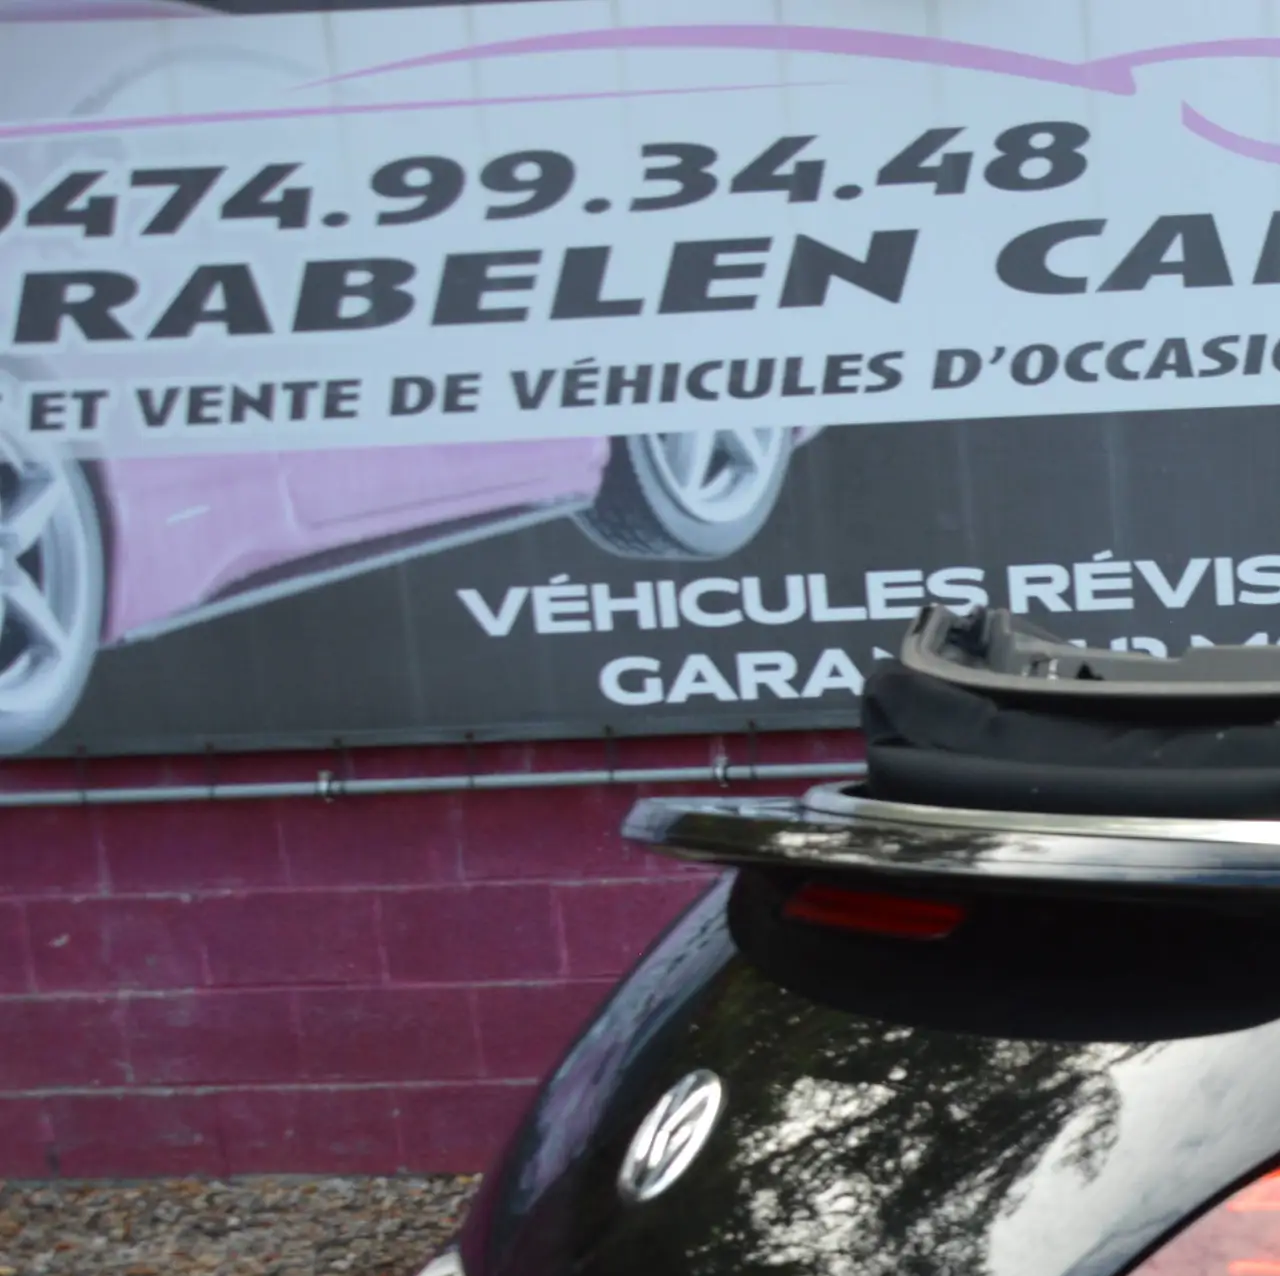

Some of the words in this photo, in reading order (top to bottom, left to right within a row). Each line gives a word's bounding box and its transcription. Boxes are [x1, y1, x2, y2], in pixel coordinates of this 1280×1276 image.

[0, 121, 1091, 238] 474.99.34.48
[12, 228, 919, 345] RABELEN
[28, 389, 109, 431] ET
[135, 378, 361, 427] VENTE
[389, 373, 481, 417] DE
[510, 350, 904, 411] VÉHICULES
[457, 567, 989, 638] VÉHICULES
